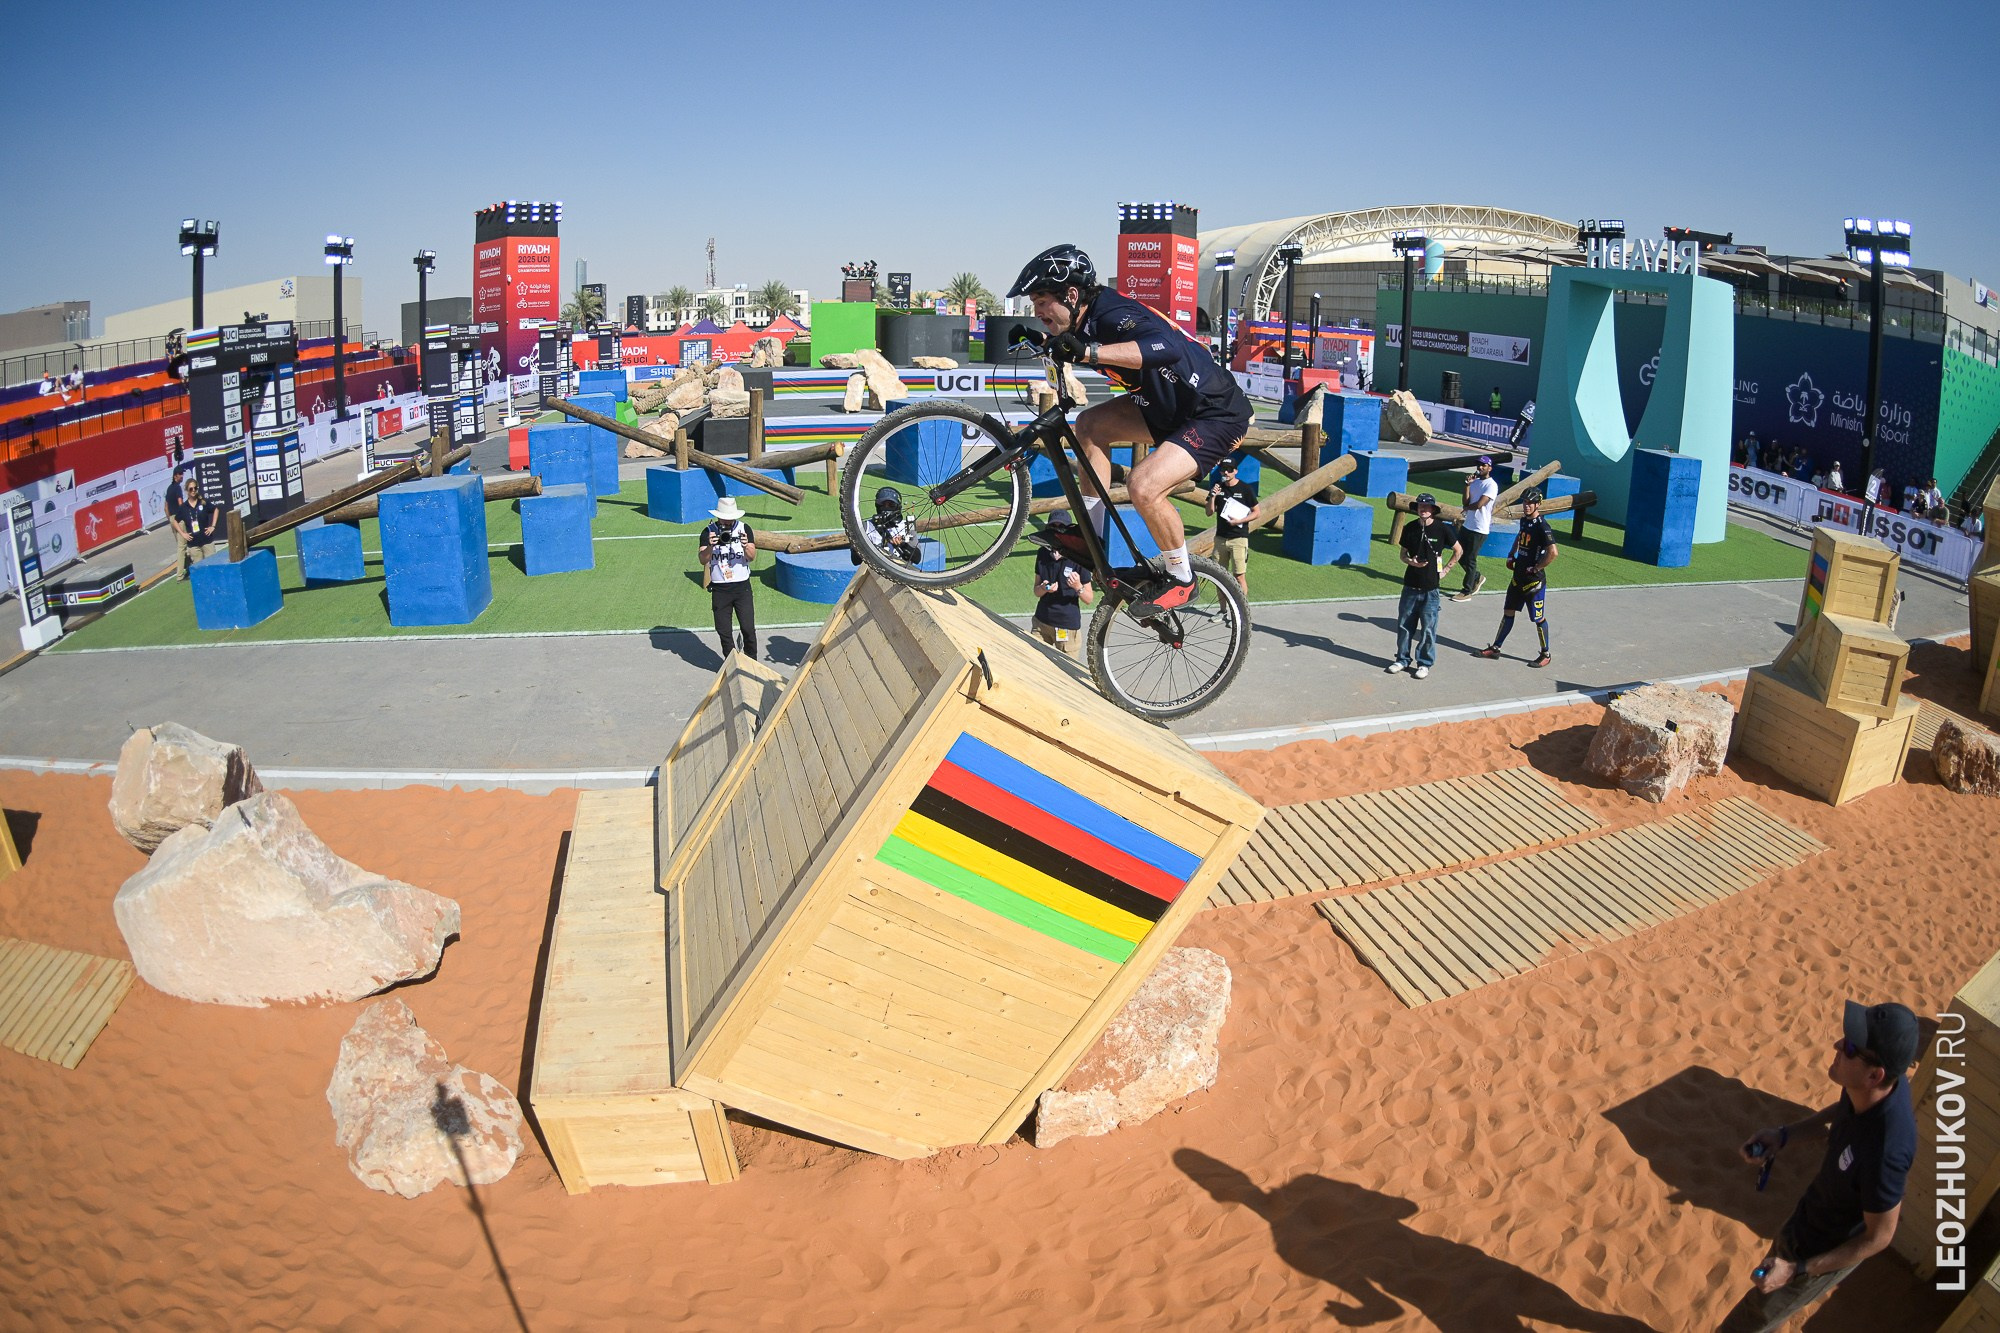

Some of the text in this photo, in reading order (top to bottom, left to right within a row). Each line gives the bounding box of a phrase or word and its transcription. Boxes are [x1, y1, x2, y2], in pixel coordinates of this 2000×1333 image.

[518, 244, 550, 254] RIYADH
[1128, 242, 1161, 251] RIYADH
[1177, 243, 1195, 254] RIYADH
[480, 247, 501, 260] RIYADH
[226, 329, 238, 340] UCI
[1422, 332, 1438, 340] URBAN
[1438, 333, 1458, 342] CYCLING
[1472, 336, 1489, 345] RIYADH
[1322, 340, 1349, 352] RIYADH
[1412, 339, 1467, 352] WORLD CHAMPIONSHIPS
[1471, 346, 1504, 357] SAUDI ARABIA
[250, 353, 268, 363] FINISH
[633, 356, 648, 364] UCI
[1322, 351, 1337, 360] 2025
[226, 373, 238, 385] UCI
[937, 375, 979, 391] UCI
[1526, 403, 1535, 414] 3
[1880, 400, 1911, 428] وزارة
[461, 416, 473, 424] UCI
[164, 425, 184, 437] RIYADH
[368, 424, 372, 436] 3
[1830, 412, 1864, 437] Ministry
[1881, 425, 1910, 445] Sport
[262, 472, 279, 482] UCI
[235, 487, 247, 499] UCI
[1728, 472, 1786, 504] SSOT
[1869, 480, 1877, 494] 2
[115, 501, 133, 514] RIYADH
[15, 519, 34, 534] START
[1853, 508, 1943, 555] TISSOT
[21, 532, 34, 557] 2
[109, 582, 125, 595] UCI
[62, 594, 77, 605] UCI
